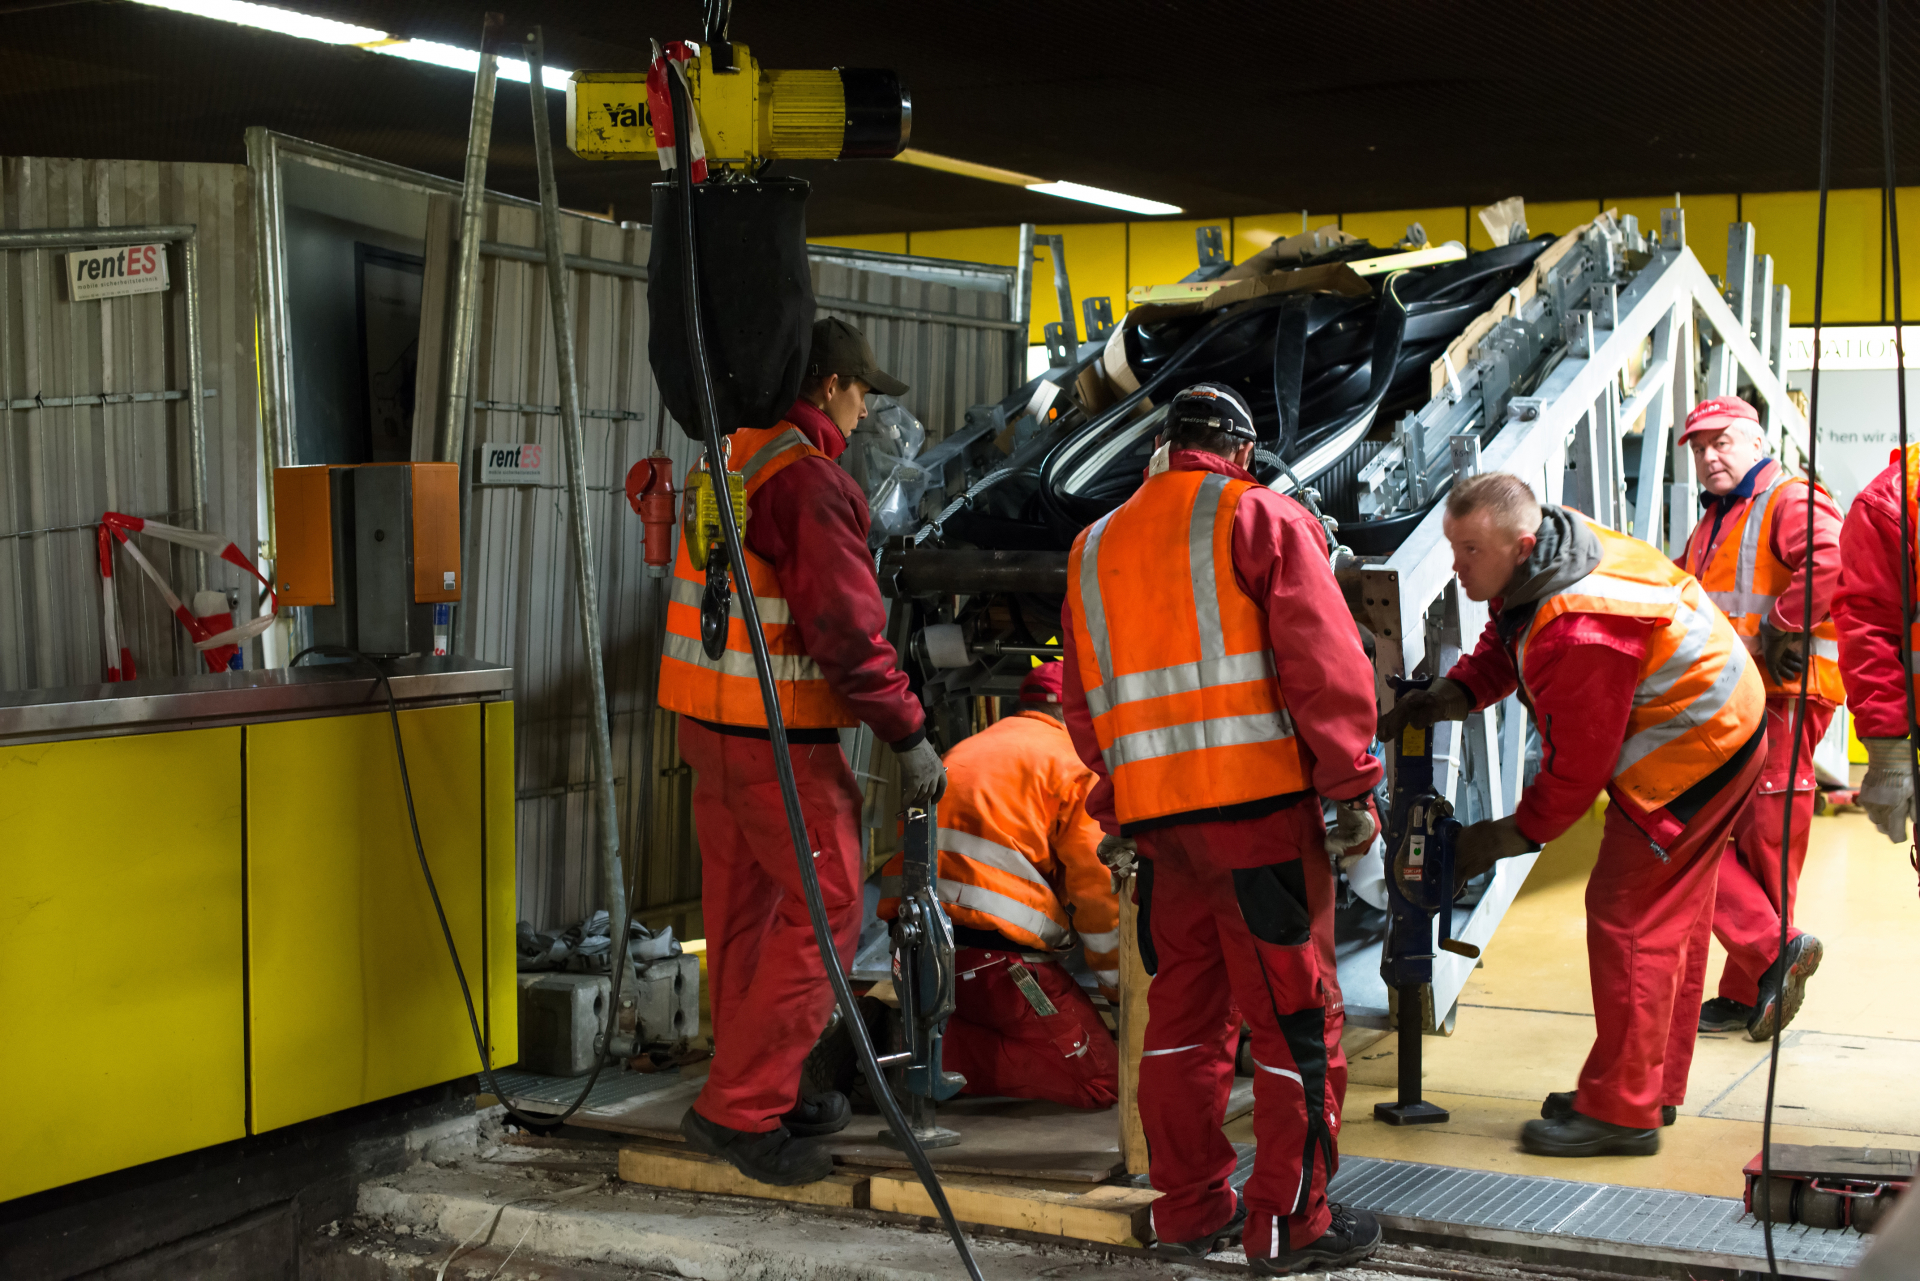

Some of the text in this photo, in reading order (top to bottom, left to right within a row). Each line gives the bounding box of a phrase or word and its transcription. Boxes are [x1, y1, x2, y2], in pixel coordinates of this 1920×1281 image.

[77, 246, 157, 281] rentES
[1863, 430, 1885, 442] wir
[1890, 432, 1915, 443] as
[489, 445, 542, 469] rentES
